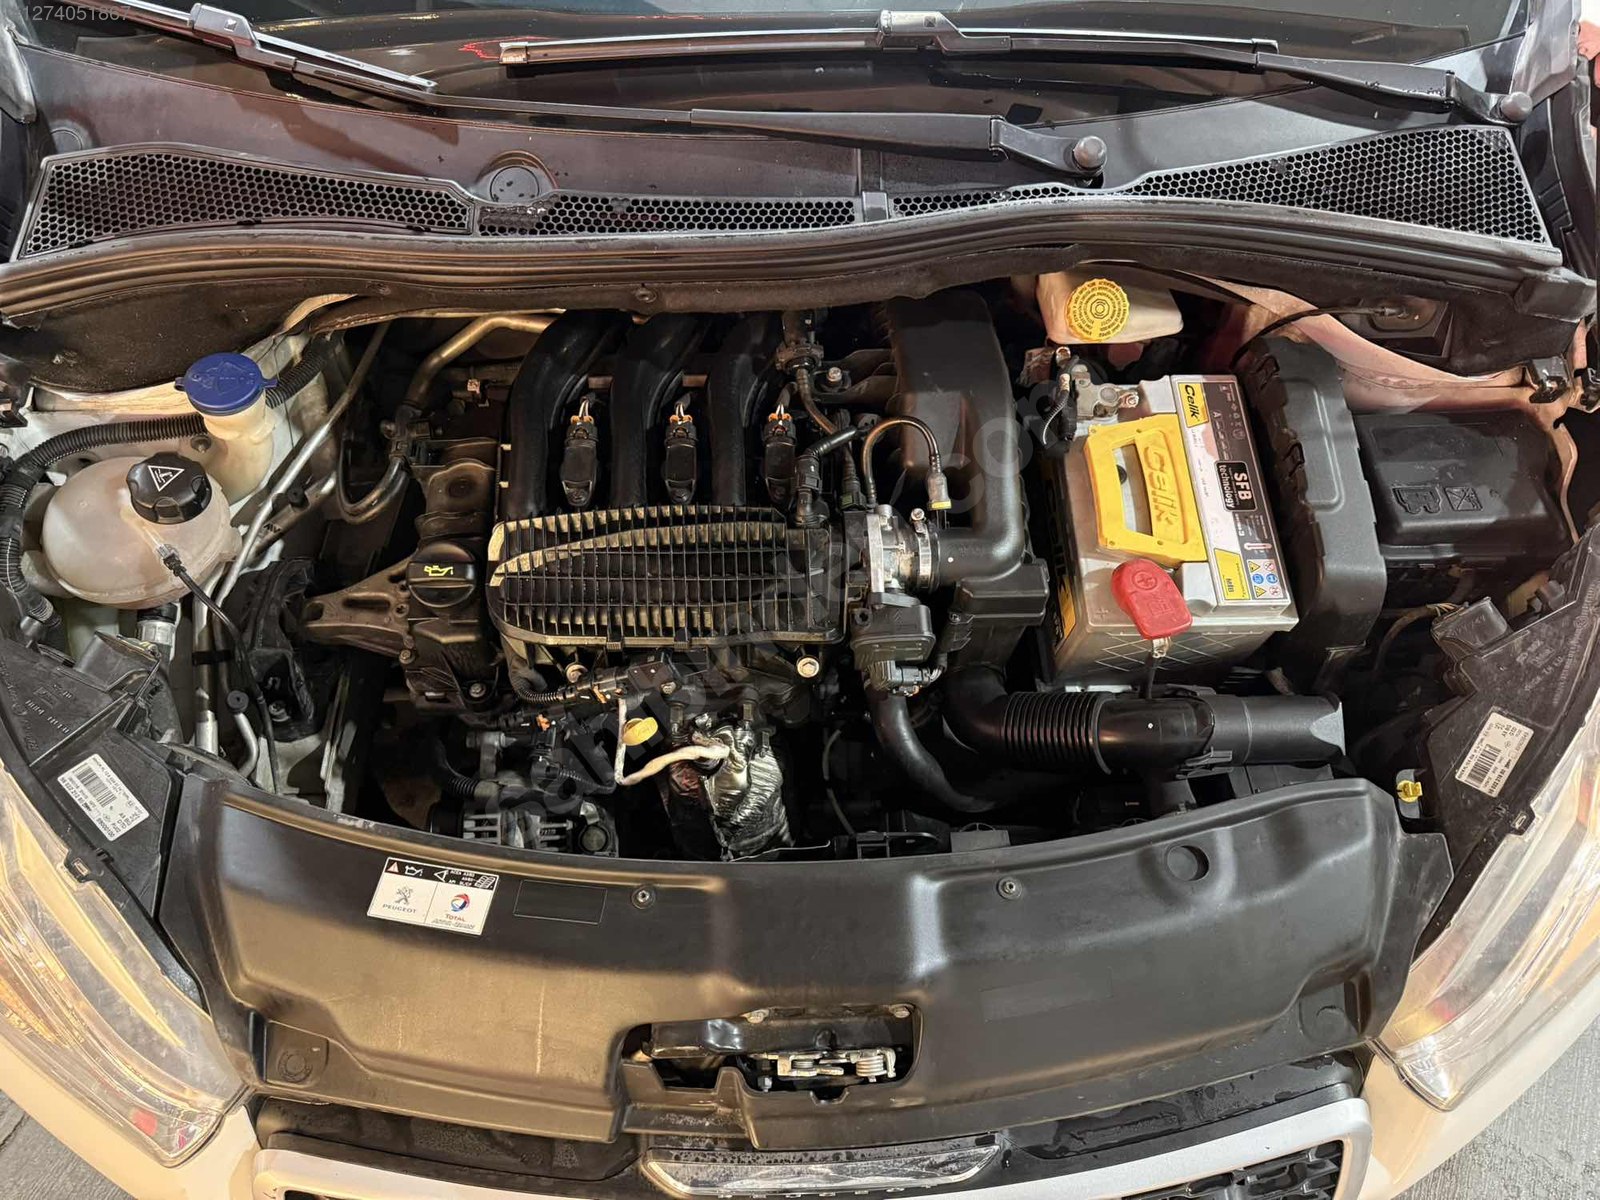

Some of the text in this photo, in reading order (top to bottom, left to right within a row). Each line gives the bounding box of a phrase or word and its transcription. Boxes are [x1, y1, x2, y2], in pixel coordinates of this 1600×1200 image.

[1218, 464, 1236, 509] technology
[1234, 471, 1252, 501] SFB
[382, 903, 417, 914] PEUGEOT
[445, 913, 466, 922] TOTAL
